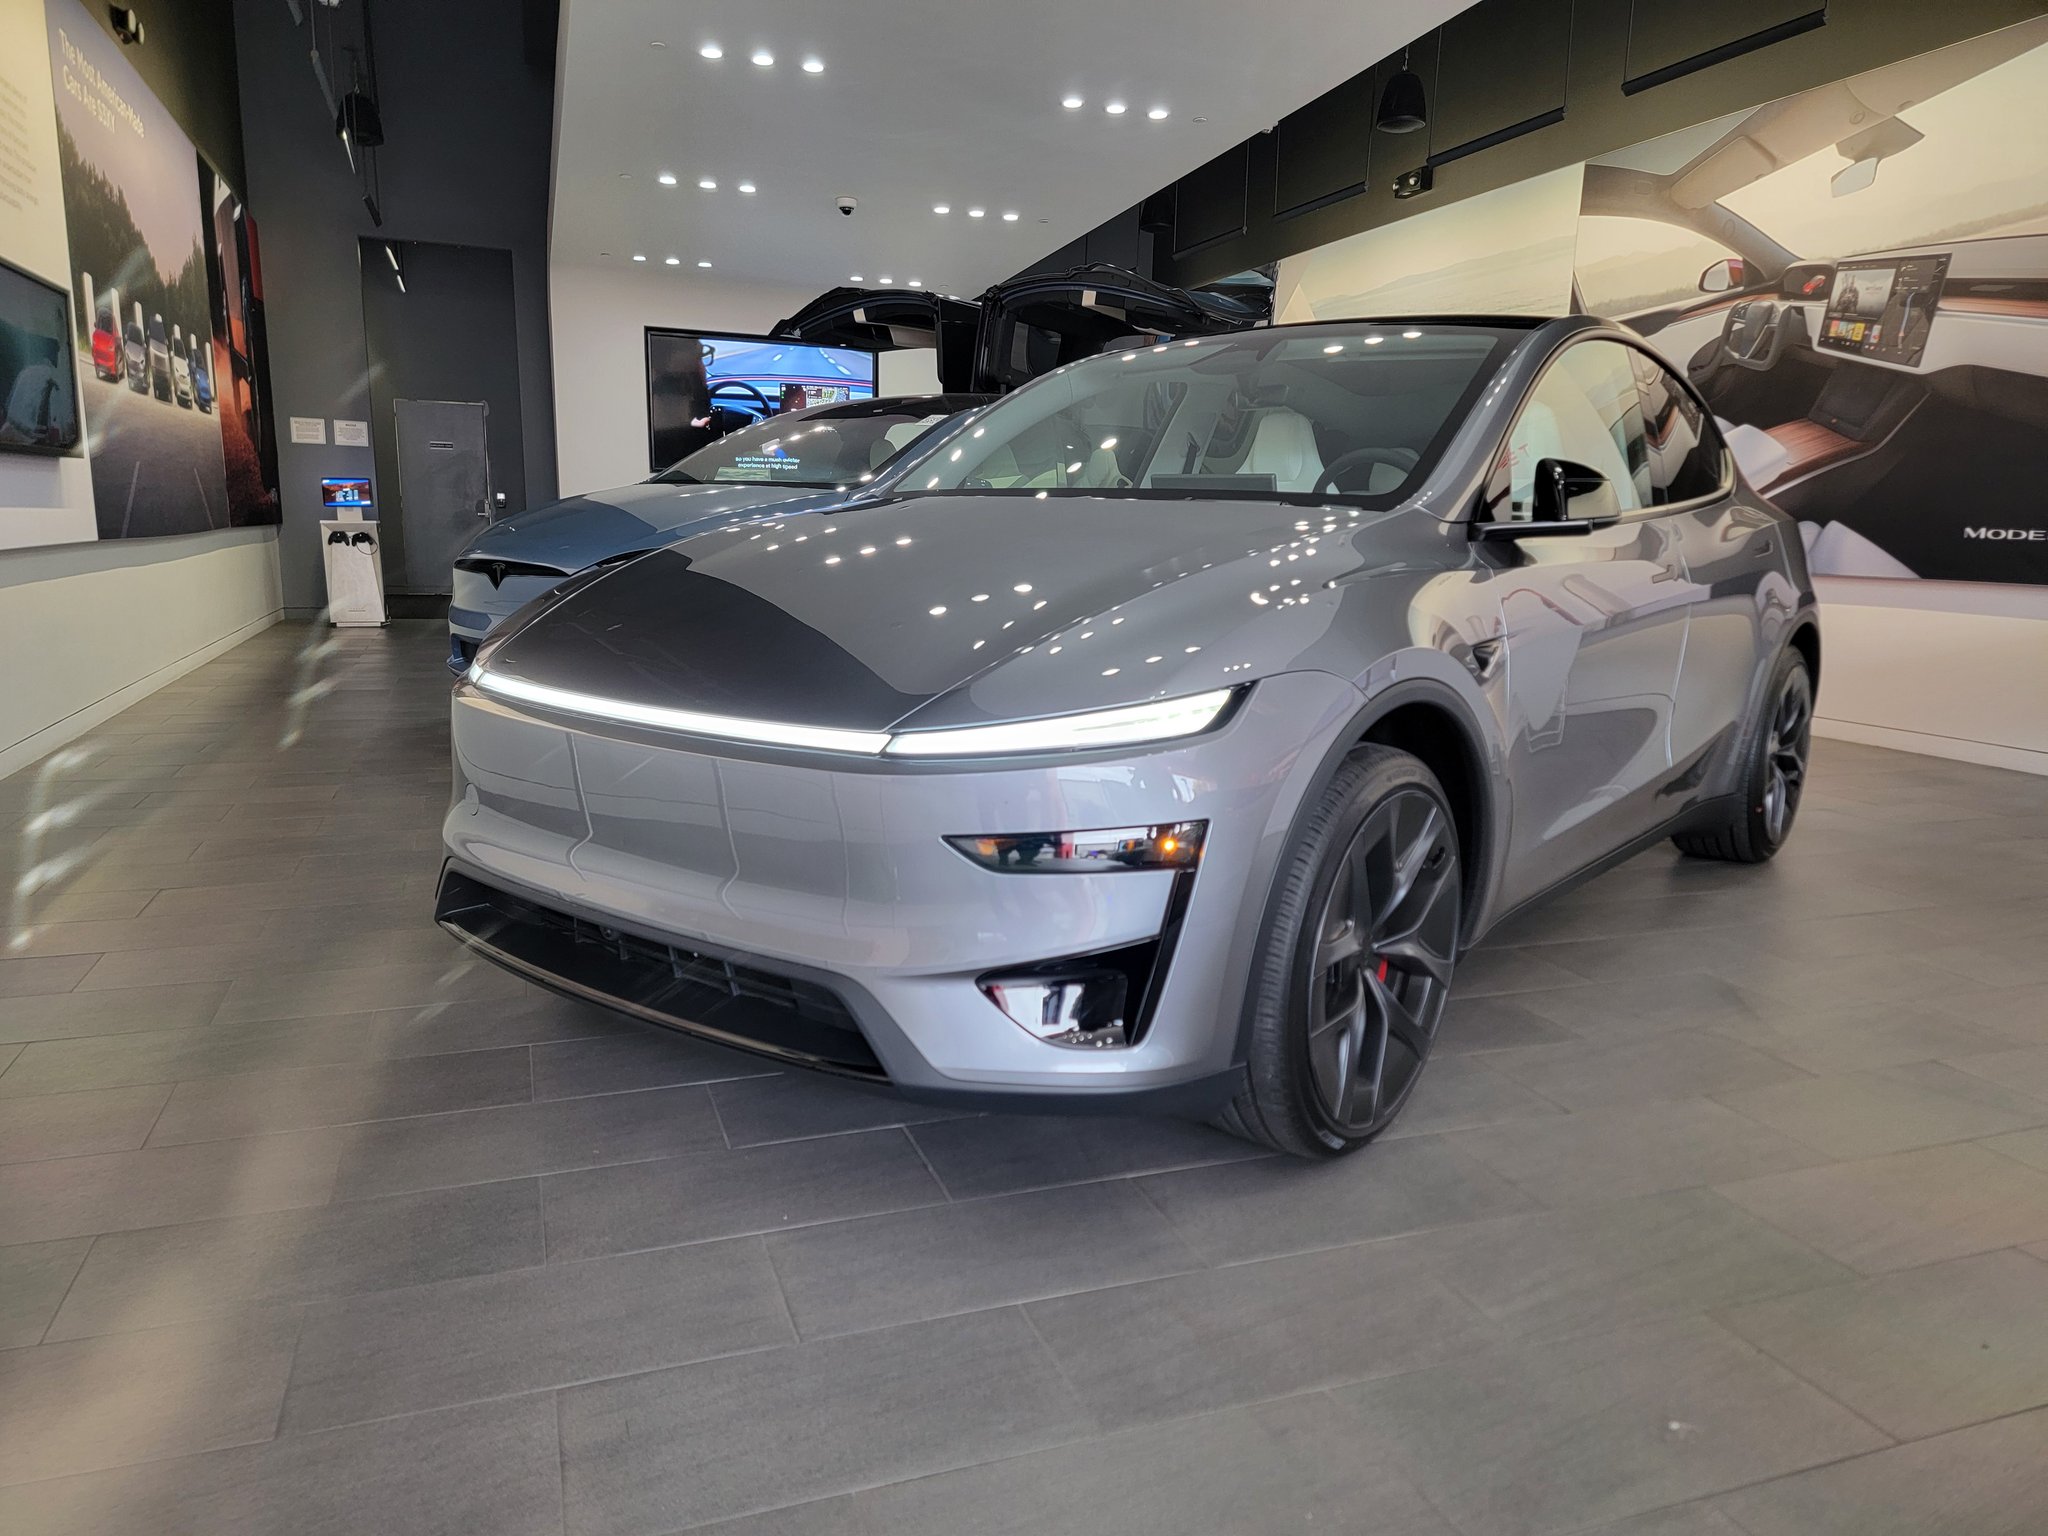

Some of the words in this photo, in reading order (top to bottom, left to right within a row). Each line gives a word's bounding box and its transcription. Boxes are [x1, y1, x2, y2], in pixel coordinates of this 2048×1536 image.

[59, 27, 76, 65] The
[76, 46, 96, 87] Most
[63, 64, 83, 102] Cars
[83, 85, 97, 116] Are
[1964, 527, 2048, 541] MODE
